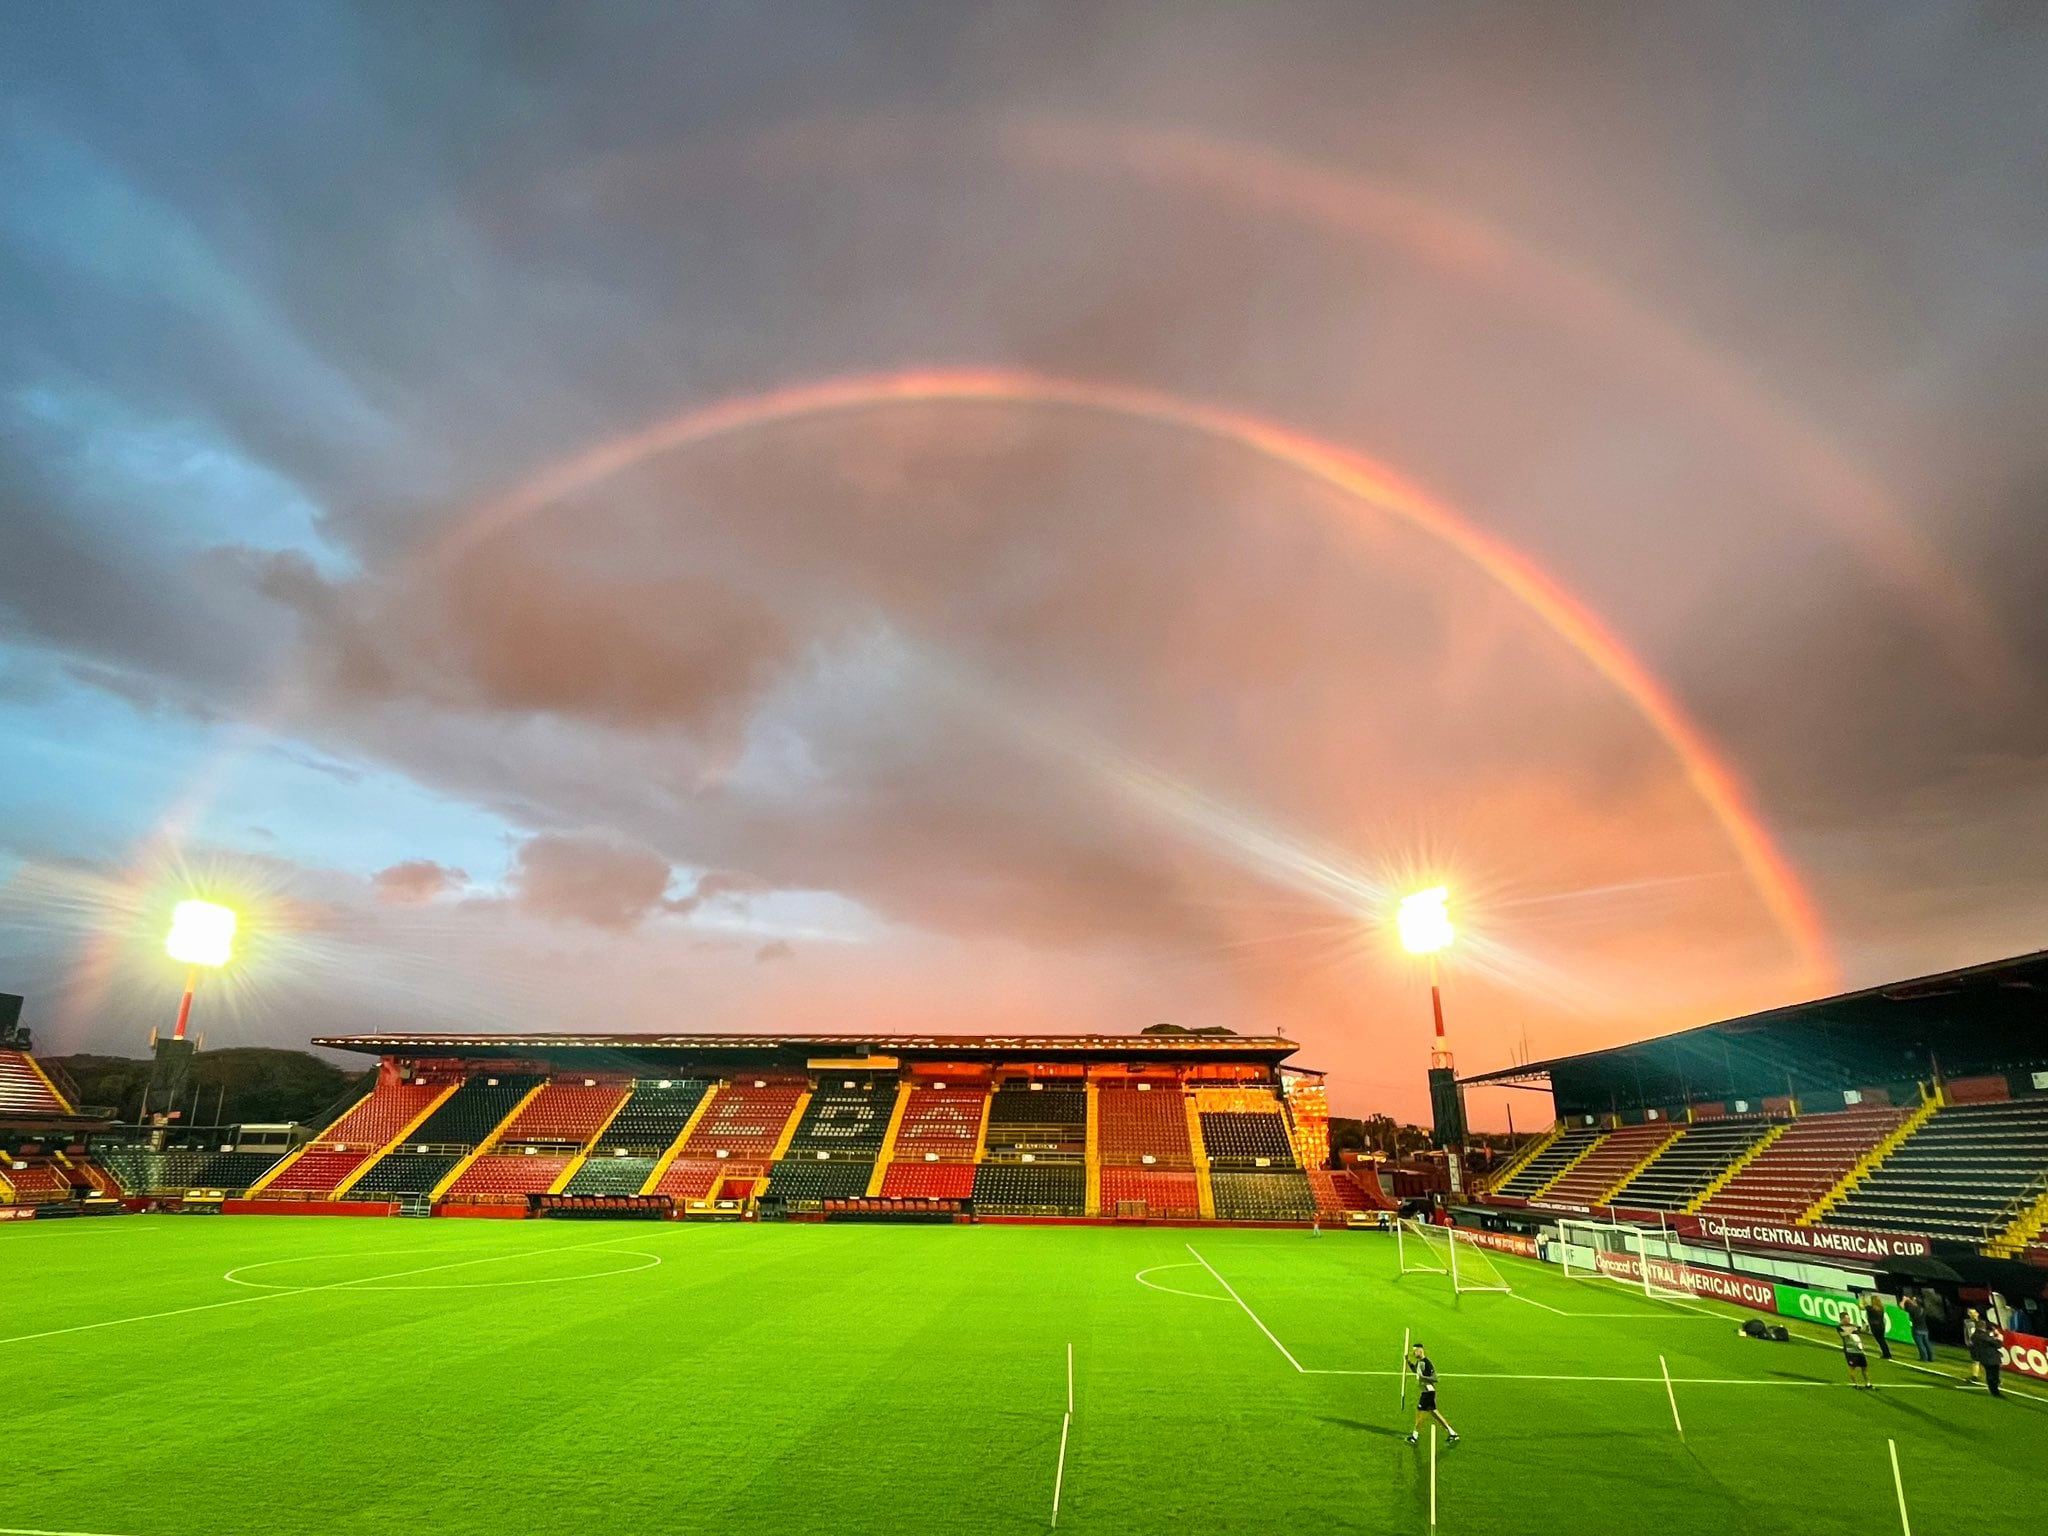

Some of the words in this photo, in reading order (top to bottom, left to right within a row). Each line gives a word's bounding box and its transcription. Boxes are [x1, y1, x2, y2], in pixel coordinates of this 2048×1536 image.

[1753, 1226, 1810, 1247] CENTRAL
[1813, 1232, 1889, 1256] AMERICAN
[1893, 1241, 1924, 1256] CUP
[1679, 1269, 1742, 1298] AMERICAN
[1743, 1285, 1772, 1304] CUP
[1799, 1293, 1892, 1333] aram
